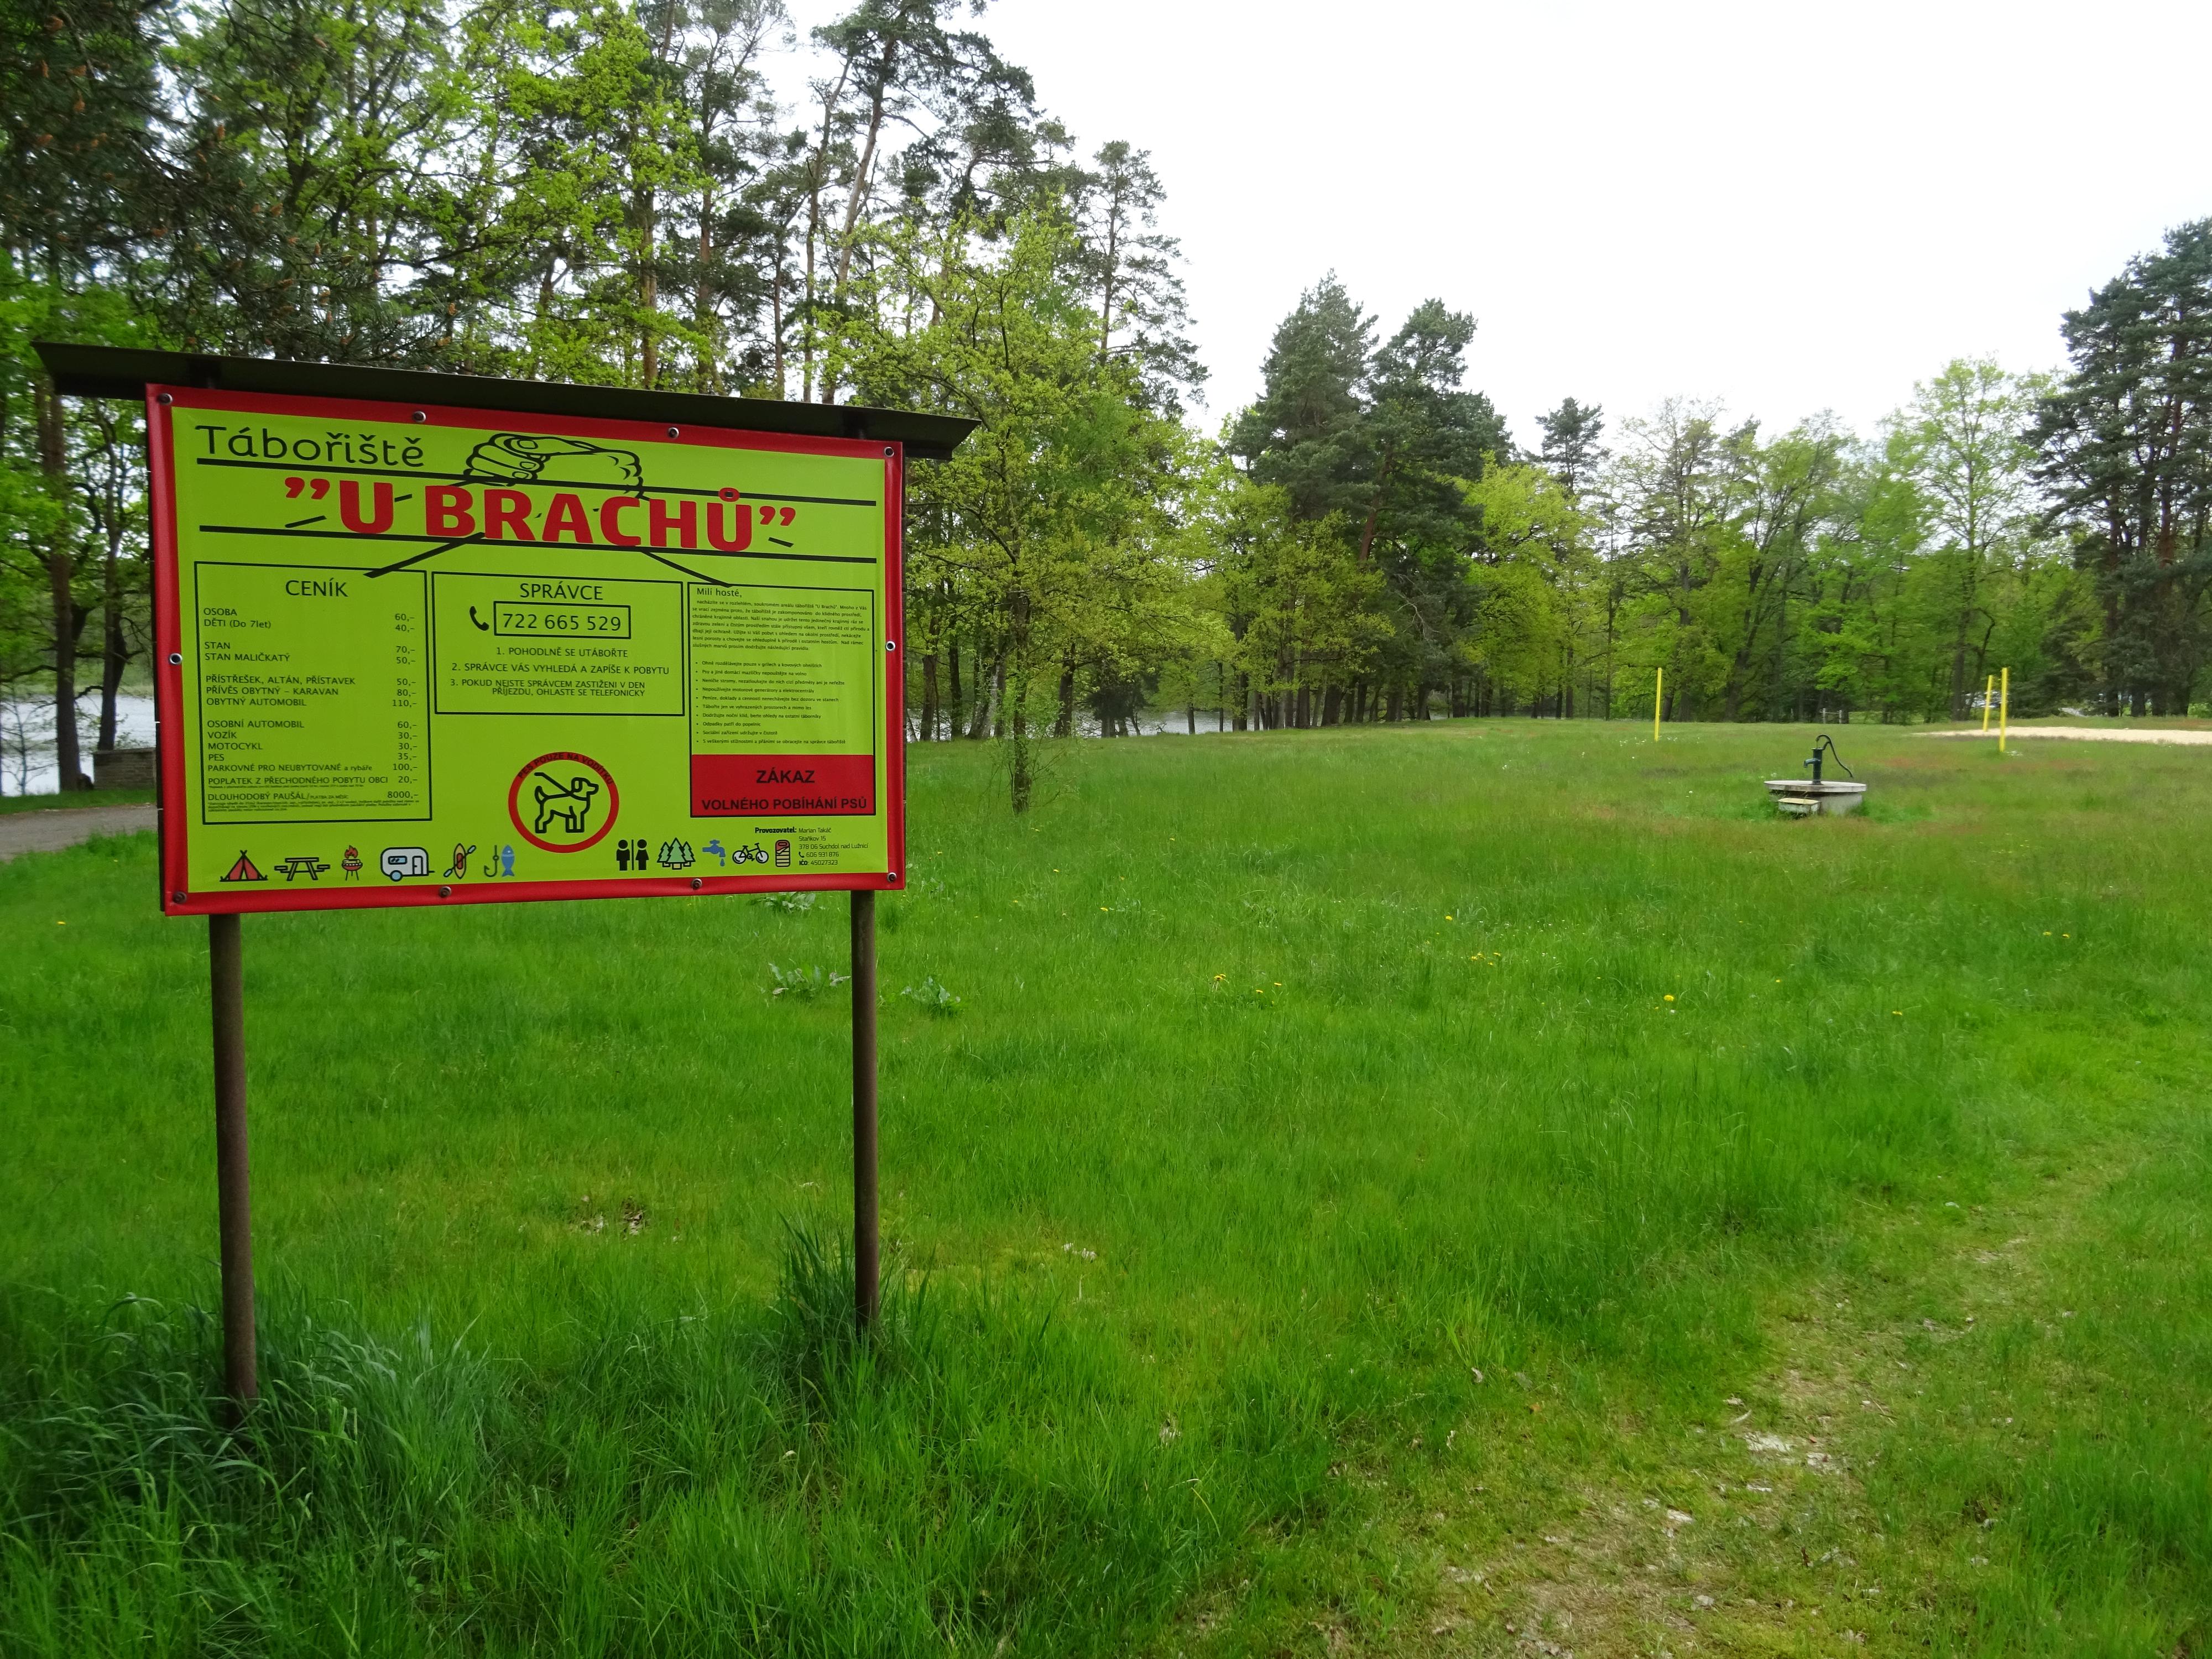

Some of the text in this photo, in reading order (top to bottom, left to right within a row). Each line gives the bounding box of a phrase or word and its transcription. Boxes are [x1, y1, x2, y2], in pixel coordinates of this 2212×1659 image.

[194, 425, 425, 467] Tábořiště
[285, 577, 348, 597] CENÍK
[520, 582, 603, 600] SPRÁVCE
[697, 587, 742, 598] Milí hosté,
[203, 607, 237, 616] OSOBA
[204, 617, 226, 627] DĚTI
[503, 613, 621, 631] 722 665 529
[234, 652, 290, 661] MALIČKATÝ
[509, 646, 562, 656] POHODLNĚ
[565, 648, 576, 656] SE
[579, 648, 628, 658] UTÁBOŘTE
[452, 662, 461, 671] 2.
[464, 661, 508, 672] SPRÁVCE
[511, 662, 530, 672] VÁS
[533, 663, 577, 673] VYHLEDÁ
[590, 664, 621, 674] ZAPÍŠE
[634, 666, 669, 675] POBYTU
[206, 674, 264, 684] PŘÍSTŘEŠEK,
[267, 675, 302, 685] ALTÁN,
[306, 675, 356, 685] PŘÍSTAVEK
[495, 680, 525, 688] NEJSTE
[527, 679, 572, 687] SPRÁVCEM
[575, 680, 617, 688] ZASTIŽENI
[206, 685, 238, 695] PŘÍVĚS
[241, 686, 280, 695] OBYTNÝ
[492, 686, 533, 696] PŘÍJEZDU,
[589, 688, 645, 697] TELEFONICKY
[249, 698, 307, 706] AUTOMOBIL
[207, 719, 244, 728] OSOBNÍ
[207, 729, 237, 739] VOZÍK
[207, 742, 263, 750] MOTOCYKL
[208, 753, 225, 761] PES
[207, 763, 255, 771] PARKOVNÉ
[278, 763, 341, 771] NEUBYTOVANÉ
[518, 765, 533, 778] PES
[534, 754, 564, 765] POUZE
[264, 775, 330, 784] PŘECHODNÉHO
[756, 766, 815, 784] ZÁKAZ
[207, 791, 270, 801] DLOUHODOBÝ
[701, 796, 867, 810] VOLNÉHO POBÍHÁNÍ PSŮ
